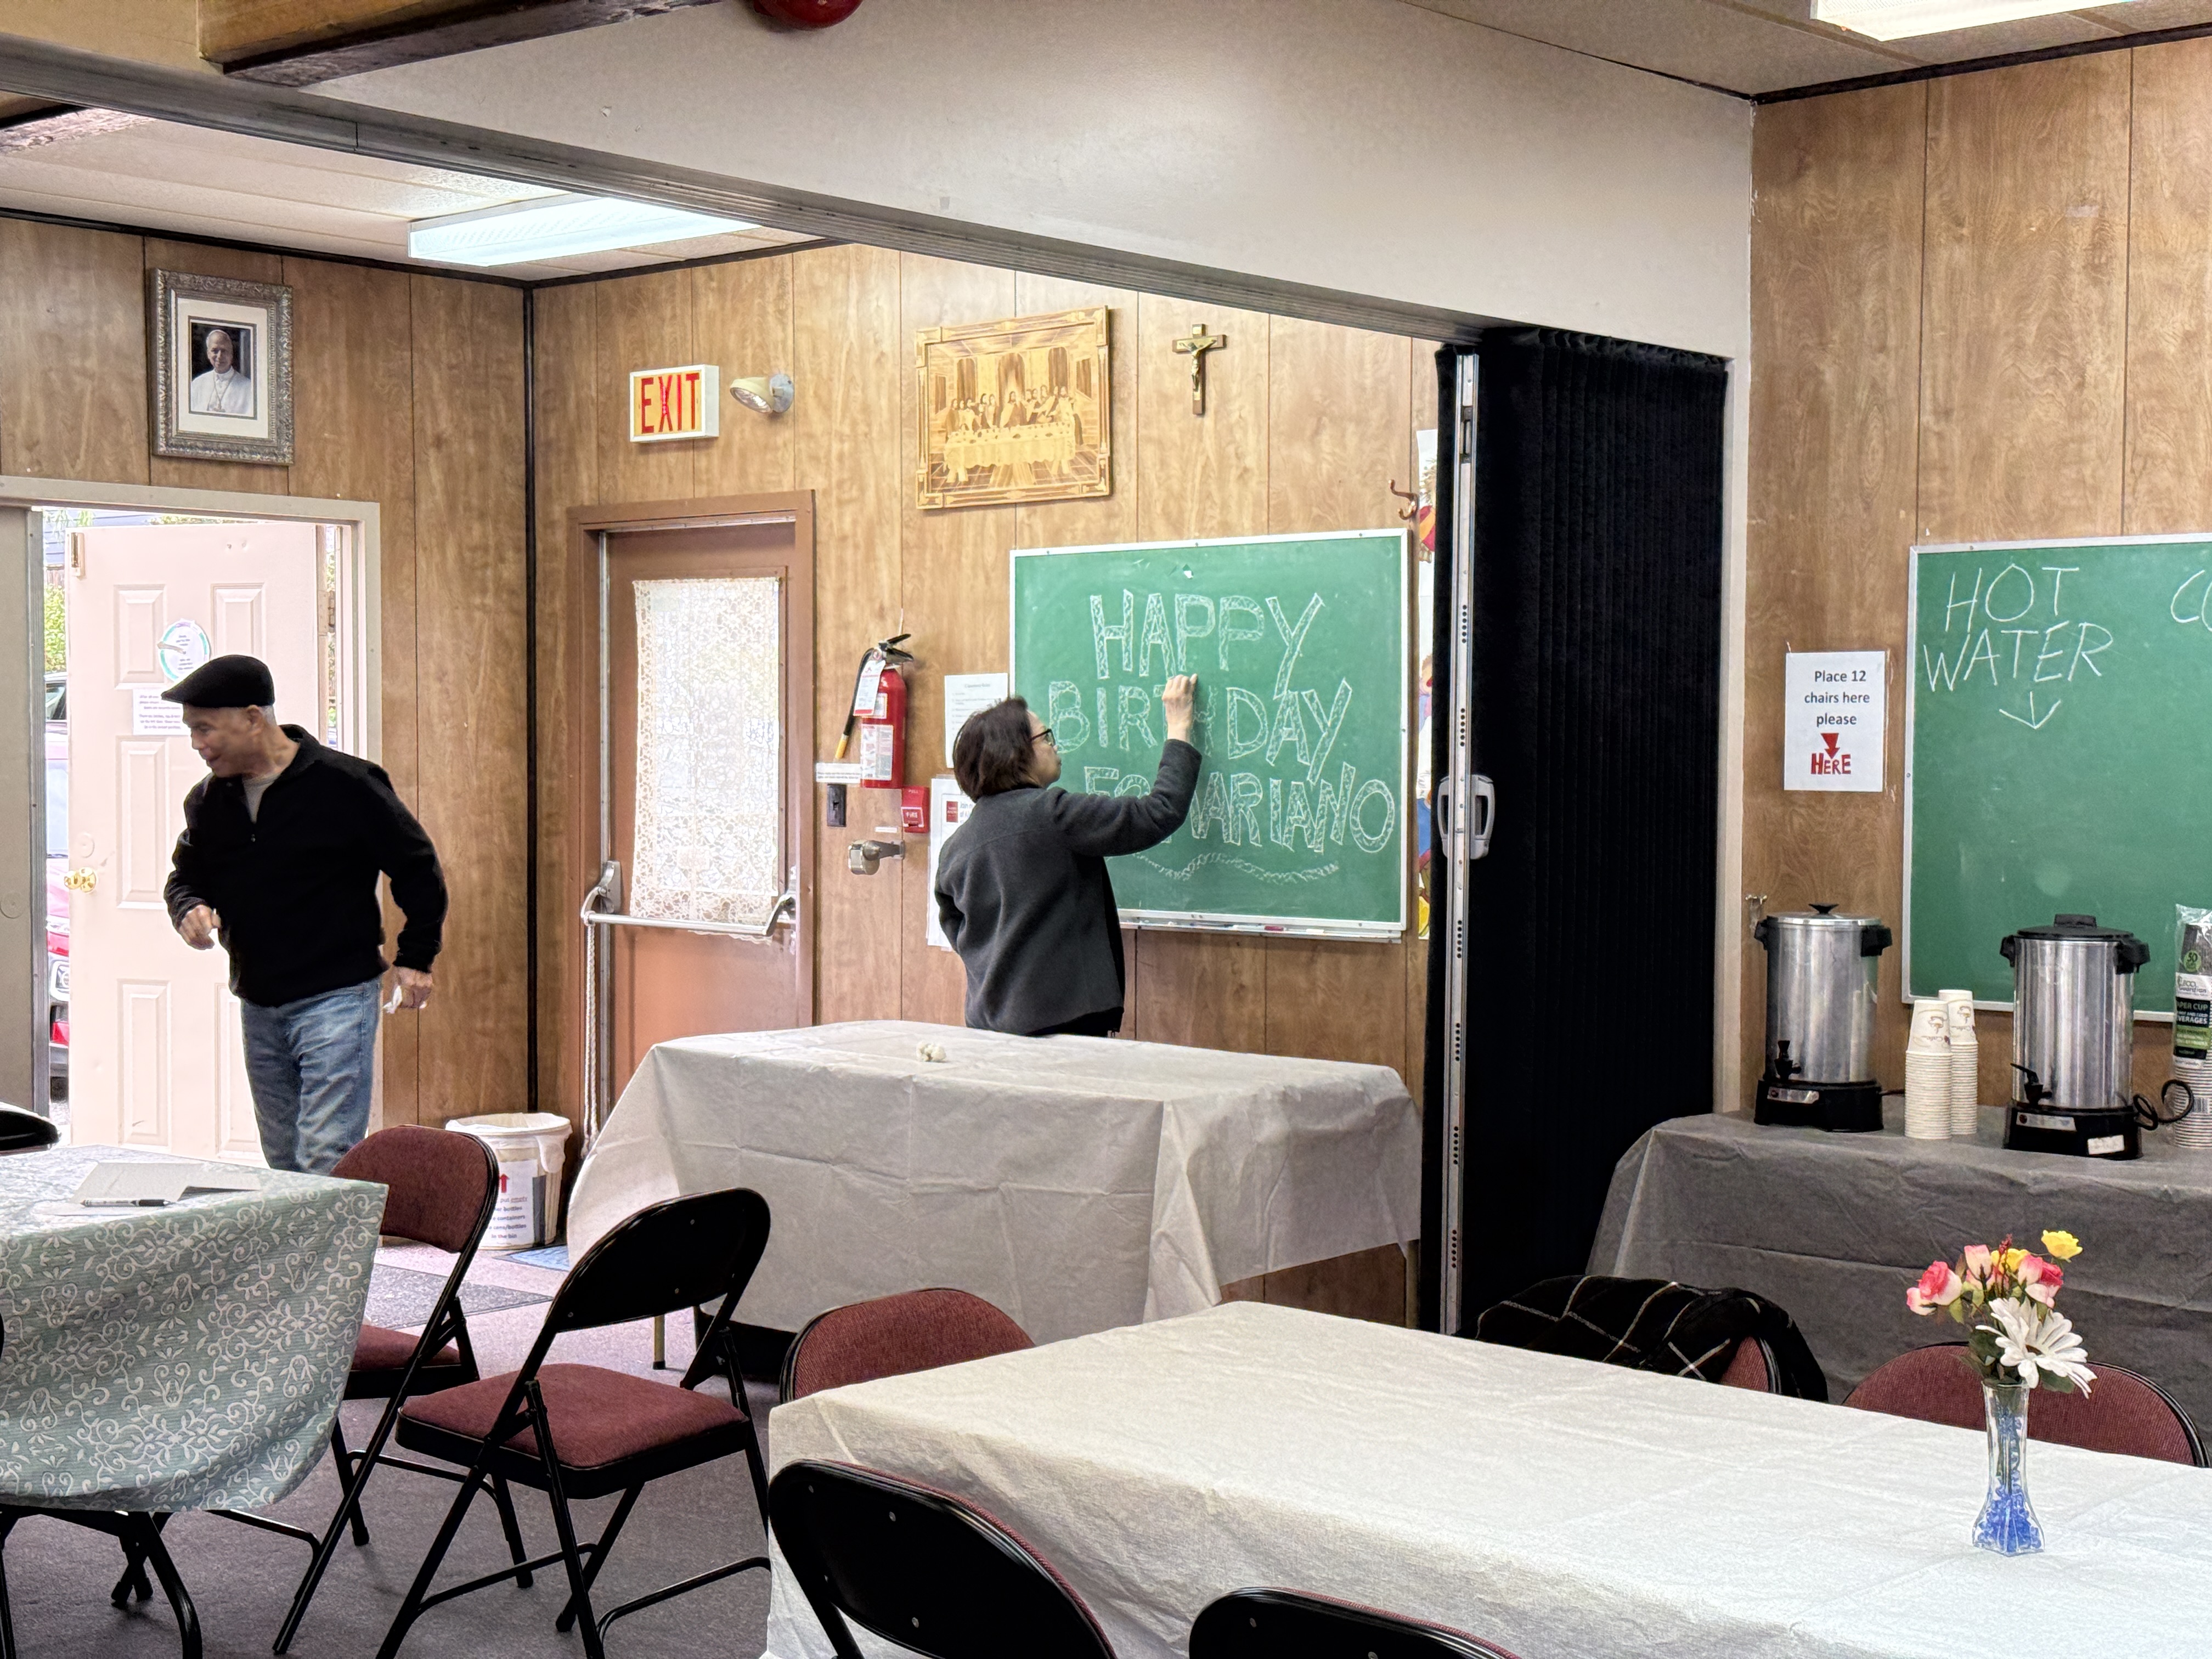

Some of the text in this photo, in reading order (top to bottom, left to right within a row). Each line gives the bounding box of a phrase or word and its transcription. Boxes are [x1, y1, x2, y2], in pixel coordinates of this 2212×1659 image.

[641, 373, 699, 433] EXIT
[1945, 563, 2080, 633] HOT
[1090, 589, 1326, 700] HAPPY
[1923, 620, 2114, 692] WATER
[1814, 670, 1867, 682] Place 12
[1804, 691, 1870, 703] chairs here
[1816, 713, 1858, 728] please
[1811, 753, 1852, 775] HERE
[2177, 1015, 2208, 1025] VERAGES
